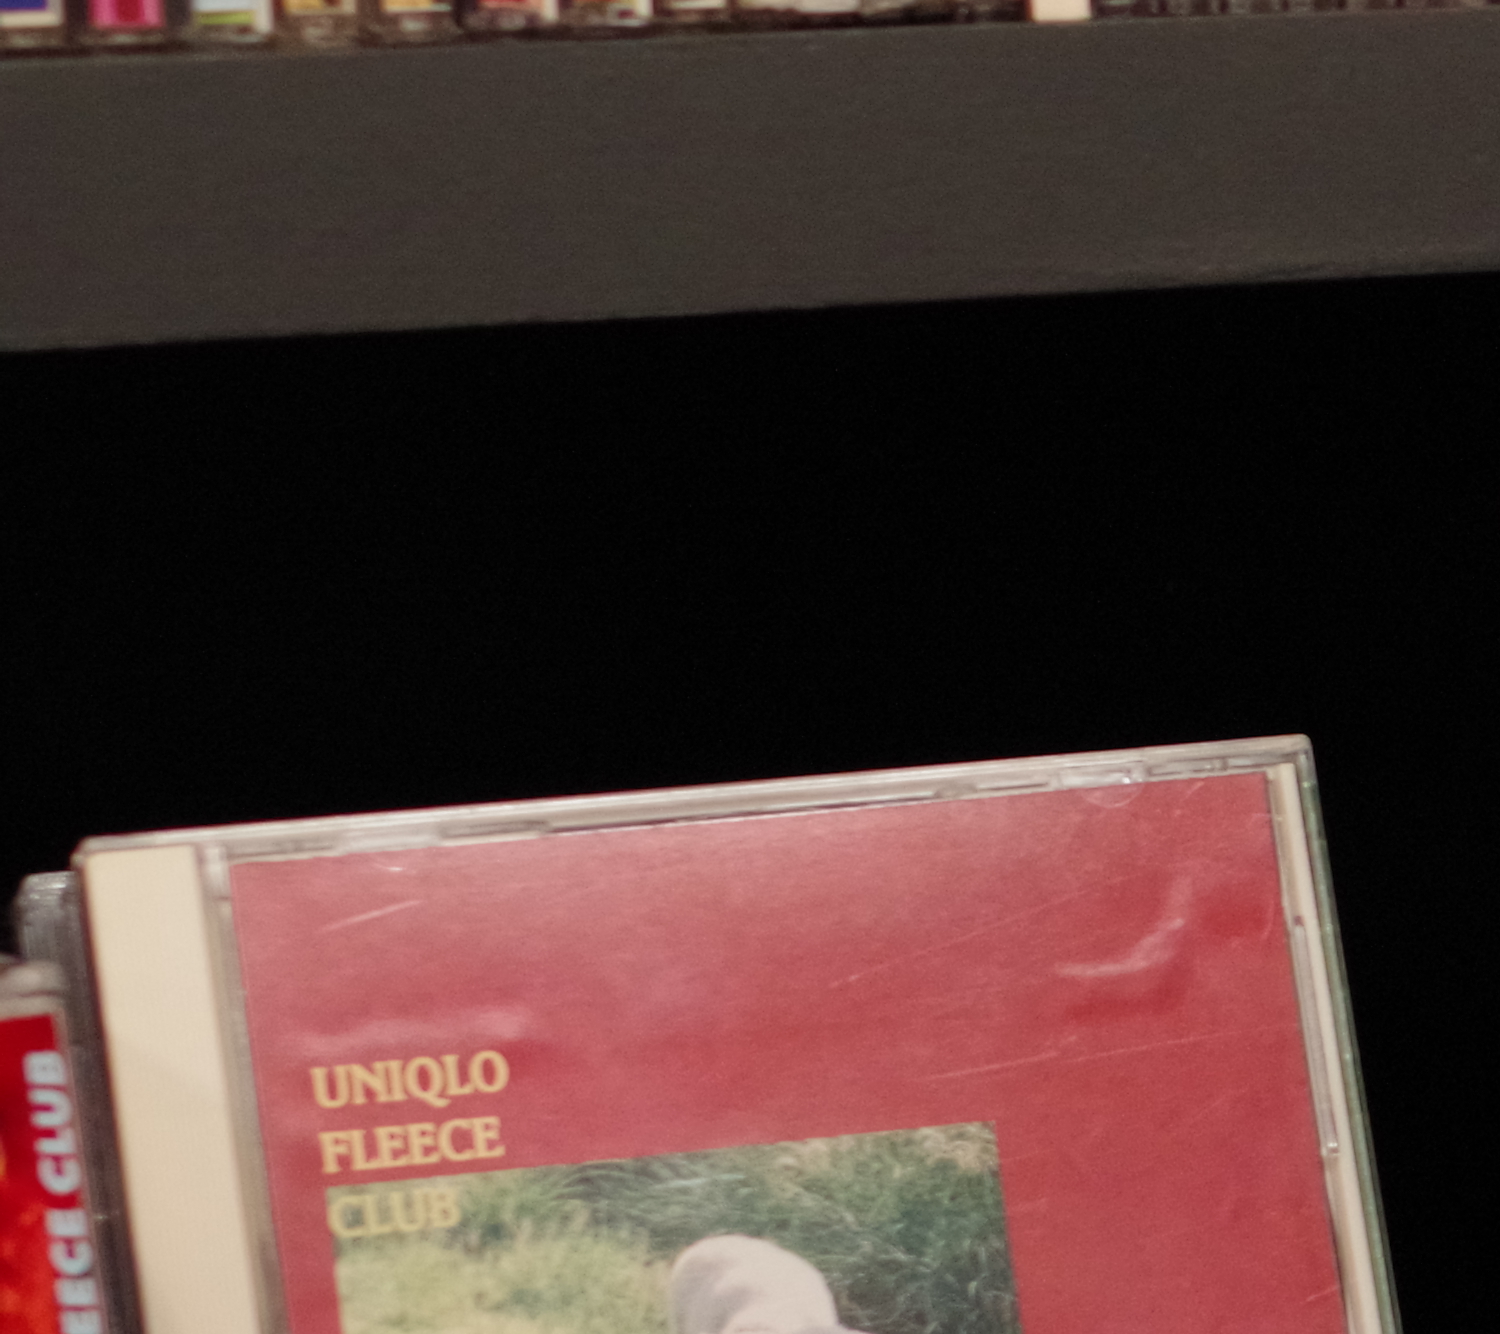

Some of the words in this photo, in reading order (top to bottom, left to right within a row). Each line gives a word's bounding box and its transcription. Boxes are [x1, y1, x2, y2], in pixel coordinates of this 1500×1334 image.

[309, 1049, 511, 1109] UNIQLO
[23, 1050, 82, 1196] CLUB
[317, 1115, 507, 1175] FLEECE
[326, 1186, 462, 1240] CLUB
